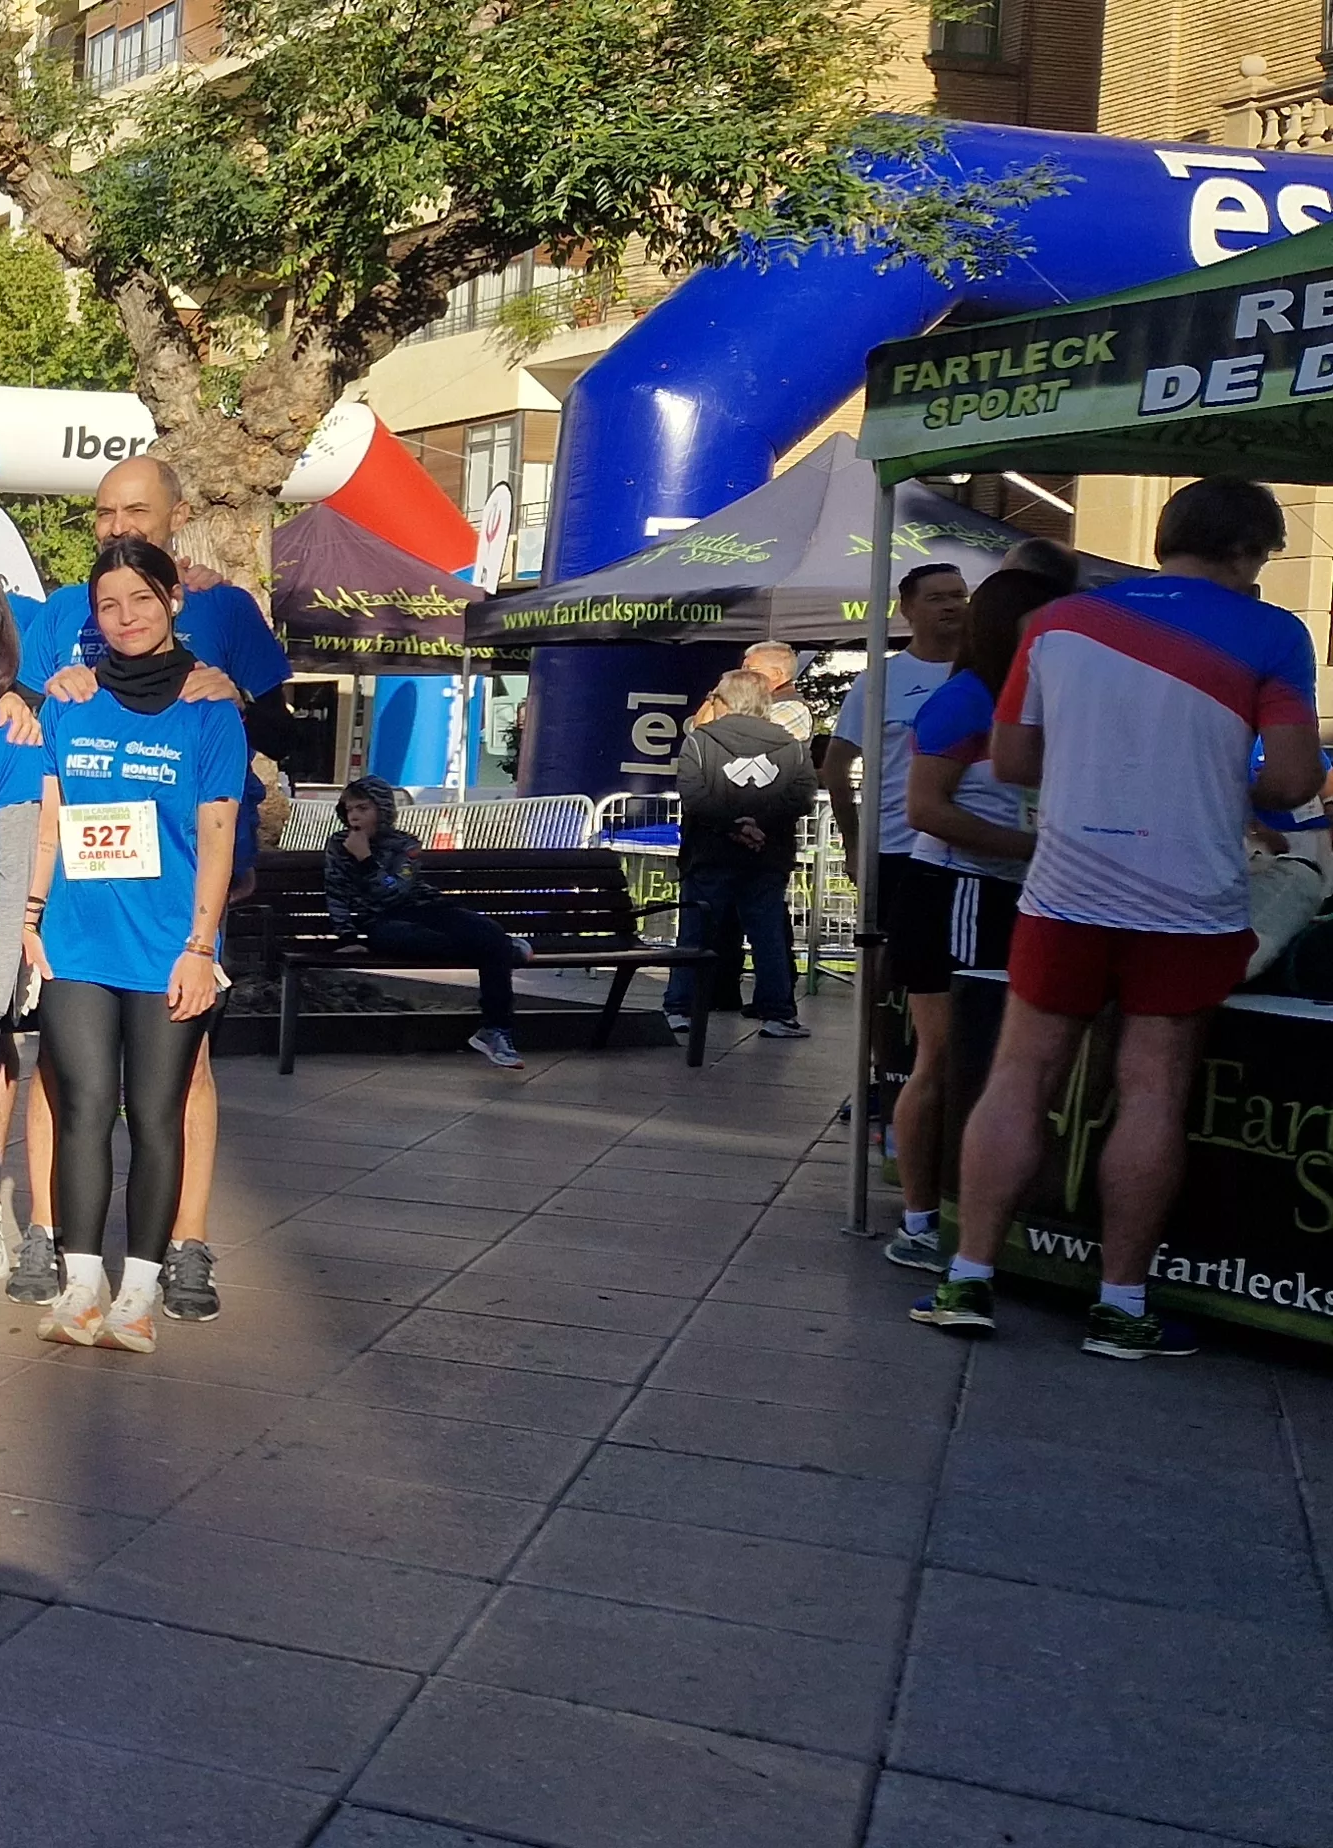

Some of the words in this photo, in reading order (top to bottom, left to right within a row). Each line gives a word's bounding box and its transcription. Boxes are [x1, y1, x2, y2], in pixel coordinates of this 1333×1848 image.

[892, 330, 1119, 394] FARTLECK
[1139, 354, 1264, 416] DE
[923, 379, 1071, 429] SPORT
[502, 594, 723, 630] www.fartlecksport.com
[138, 741, 182, 761] kablex
[66, 754, 113, 770] NEXT
[122, 763, 159, 776] HOME
[83, 826, 131, 847] 527
[78, 849, 138, 860] GABRIELA
[89, 861, 106, 871] 8K
